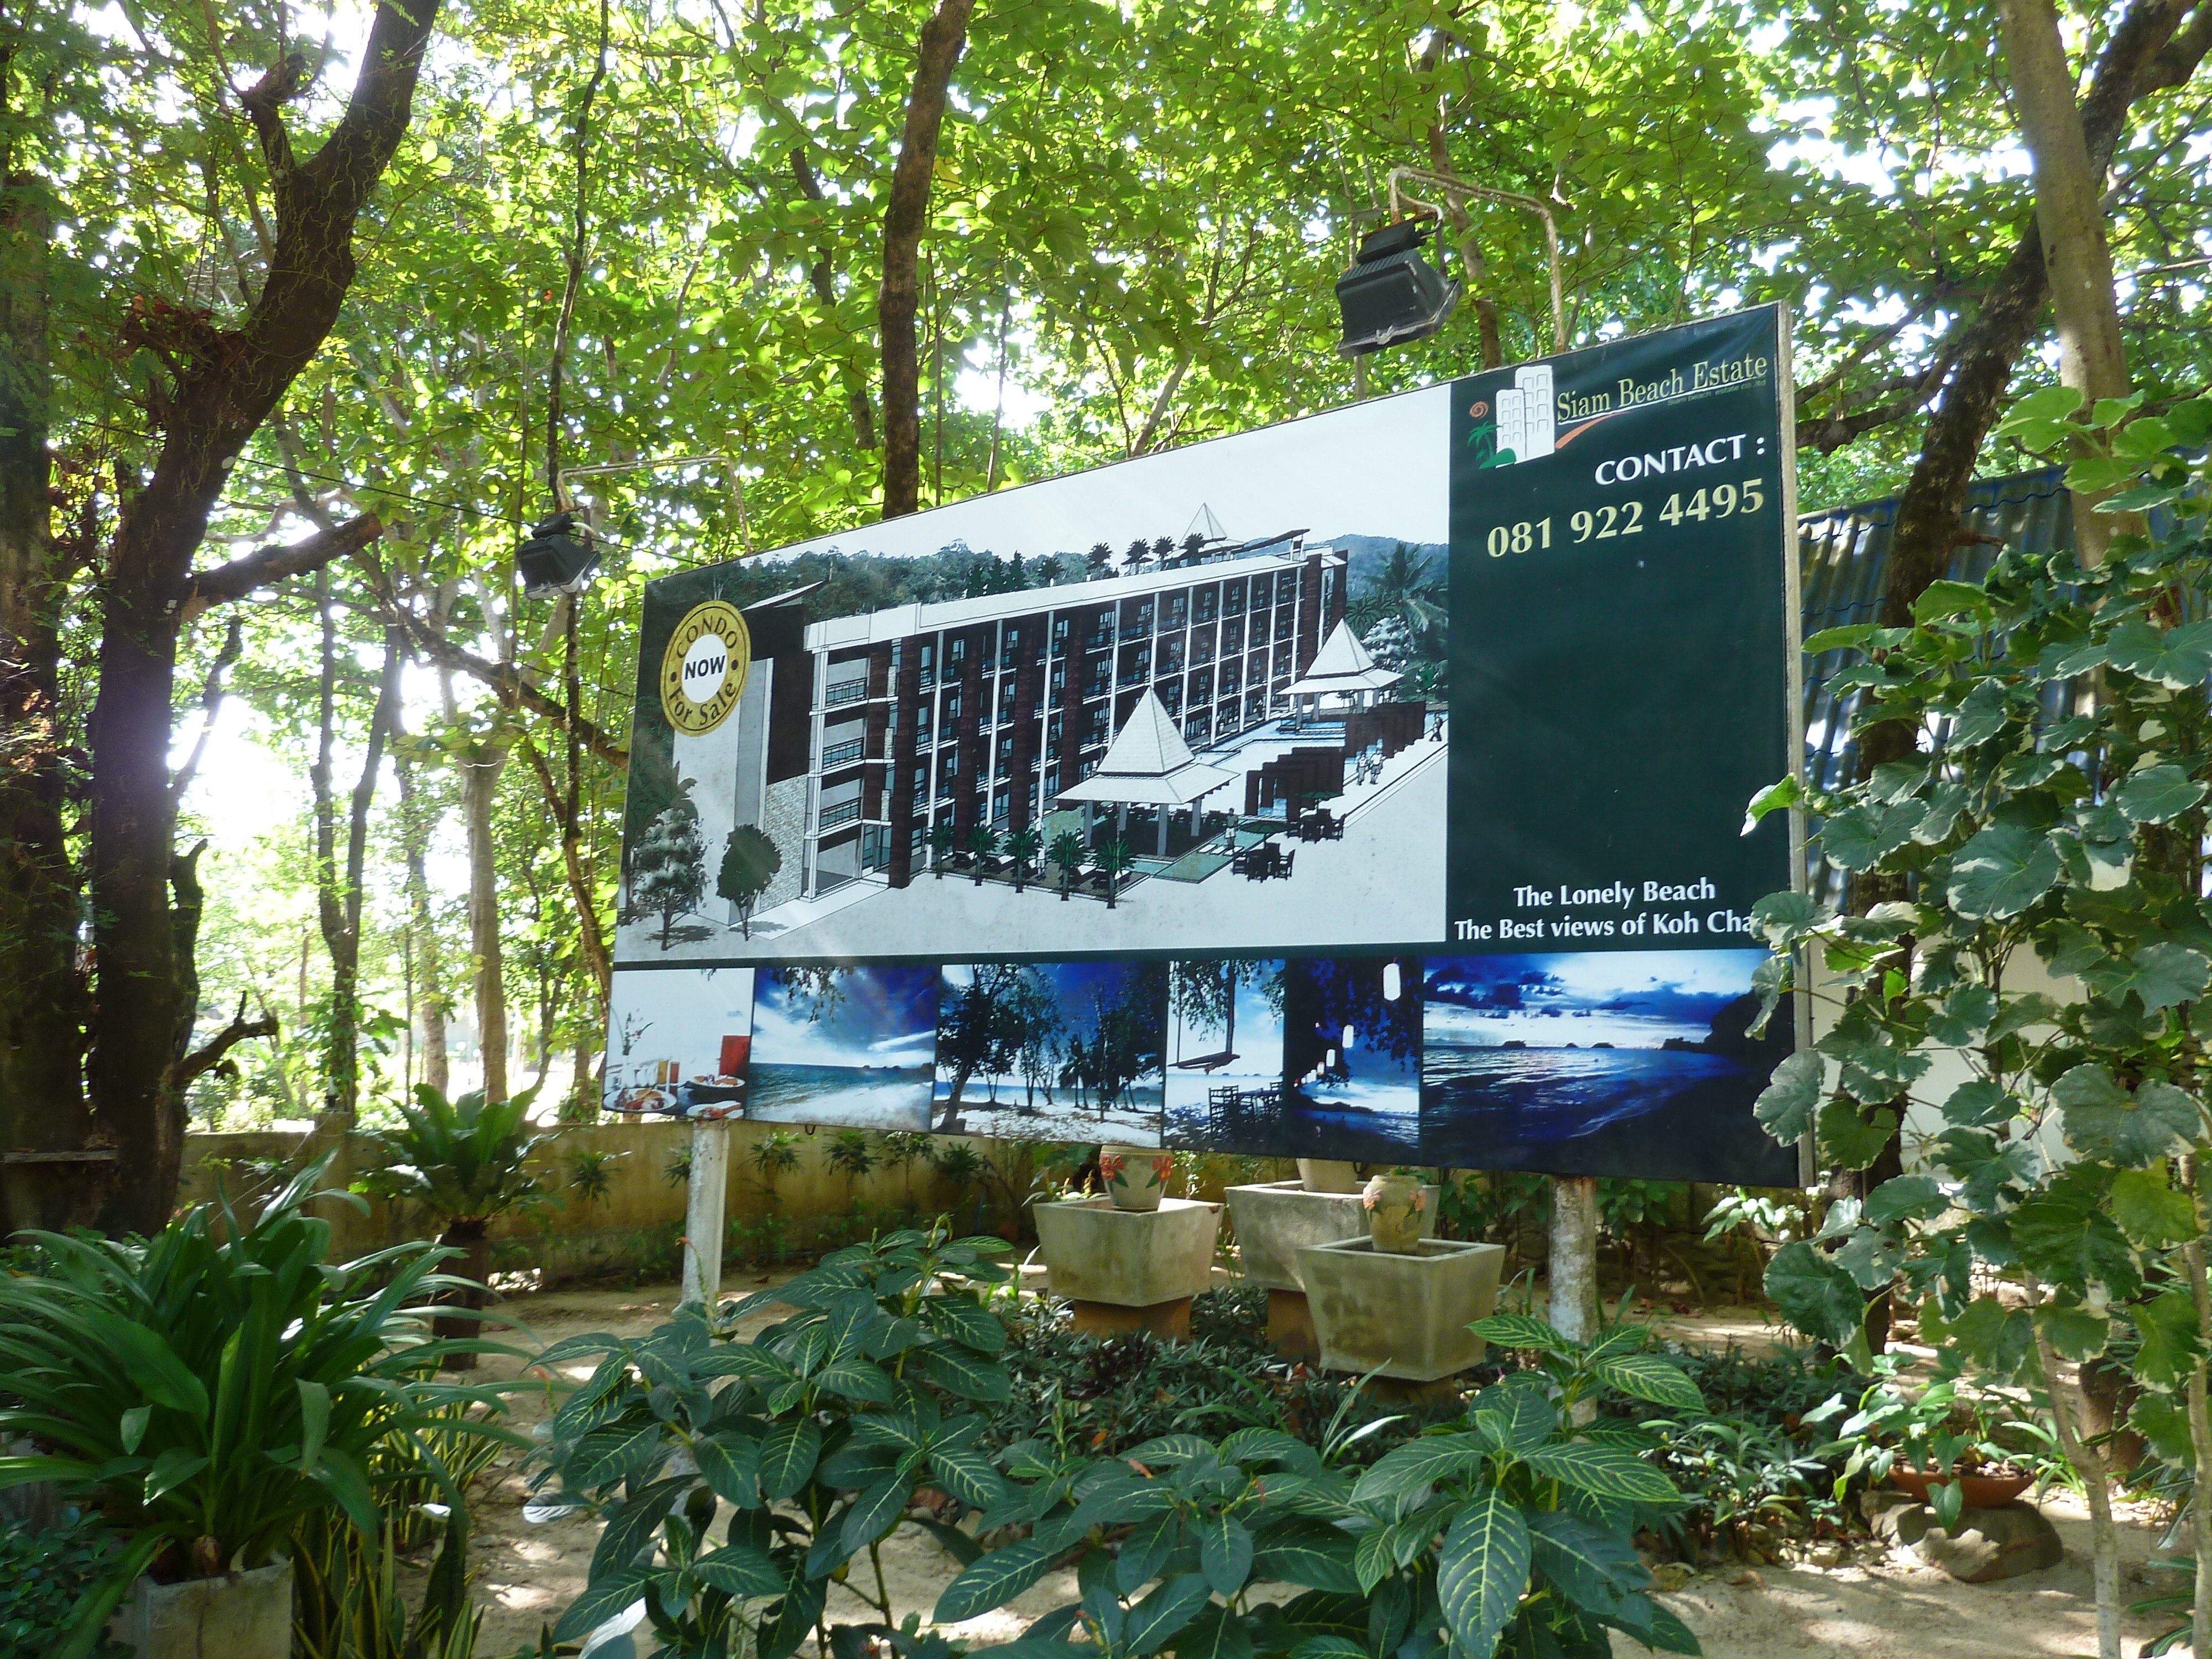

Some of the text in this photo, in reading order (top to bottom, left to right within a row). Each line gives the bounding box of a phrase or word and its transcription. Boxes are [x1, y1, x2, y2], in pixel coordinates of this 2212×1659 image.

[1557, 353, 1767, 422] Siam Beach Estate
[1594, 433, 1746, 486] CONTACT
[1487, 478, 1764, 558] 081 922 4495
[676, 615, 738, 659] CONDO
[685, 655, 726, 680] NOW
[669, 682, 737, 726] For Sale
[1513, 877, 1716, 909] The Lonely Beach
[1454, 909, 1751, 940] The Best views of Koh Cha
